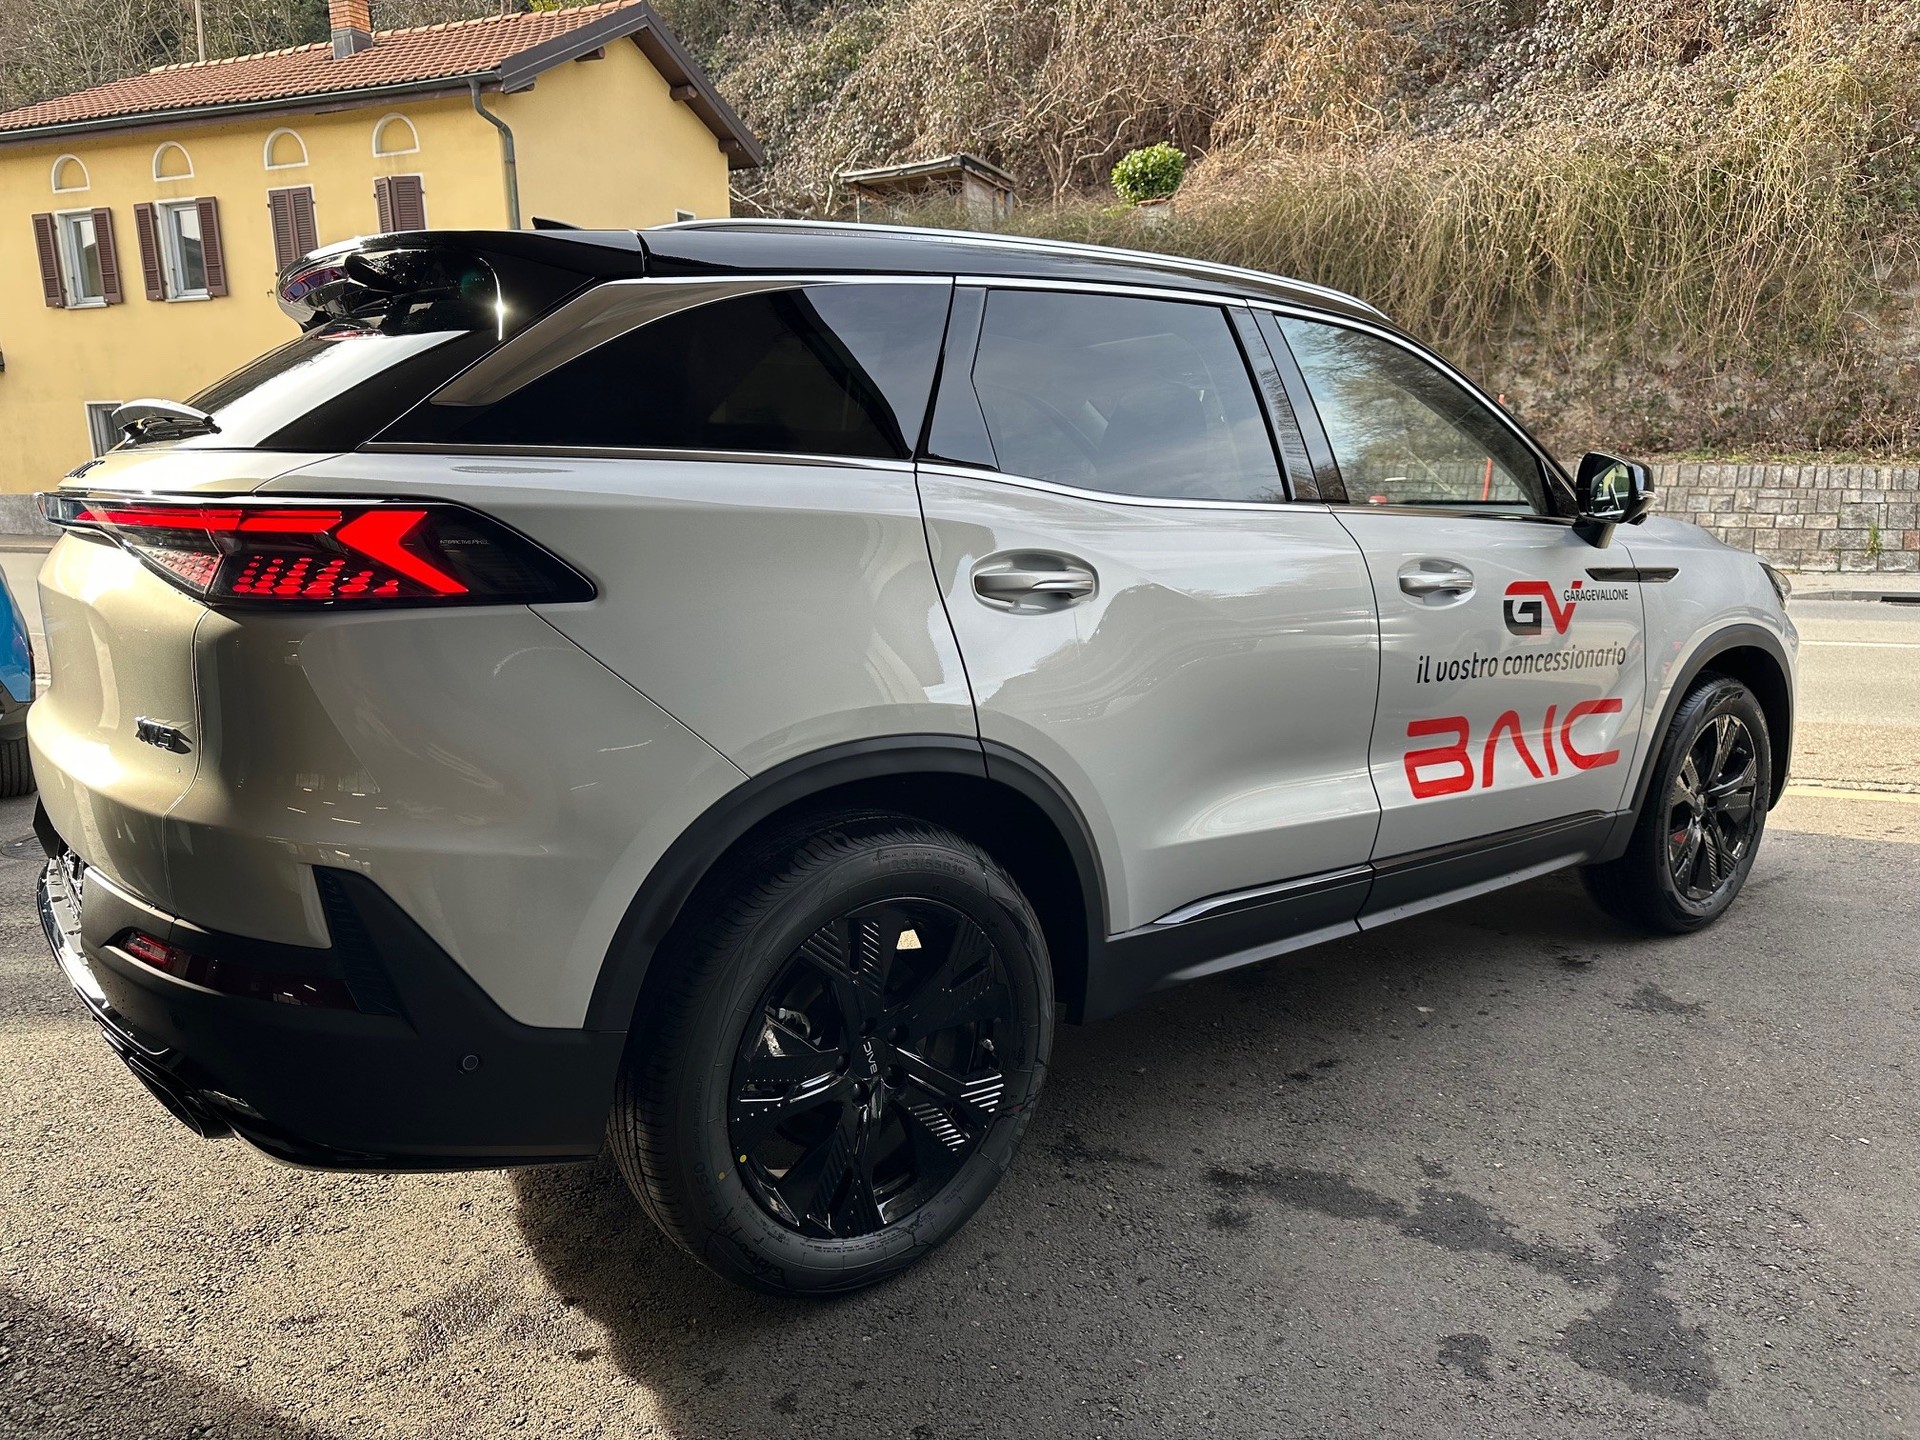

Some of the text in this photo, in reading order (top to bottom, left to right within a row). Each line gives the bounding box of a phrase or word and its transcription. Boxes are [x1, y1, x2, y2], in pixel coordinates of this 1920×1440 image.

[1563, 589, 1629, 602] GARAGEVALLONE
[1416, 655, 1431, 684] il
[1502, 641, 1626, 676] concessionario
[1404, 698, 1622, 799] BAIC
[863, 1041, 878, 1075] BAIC
